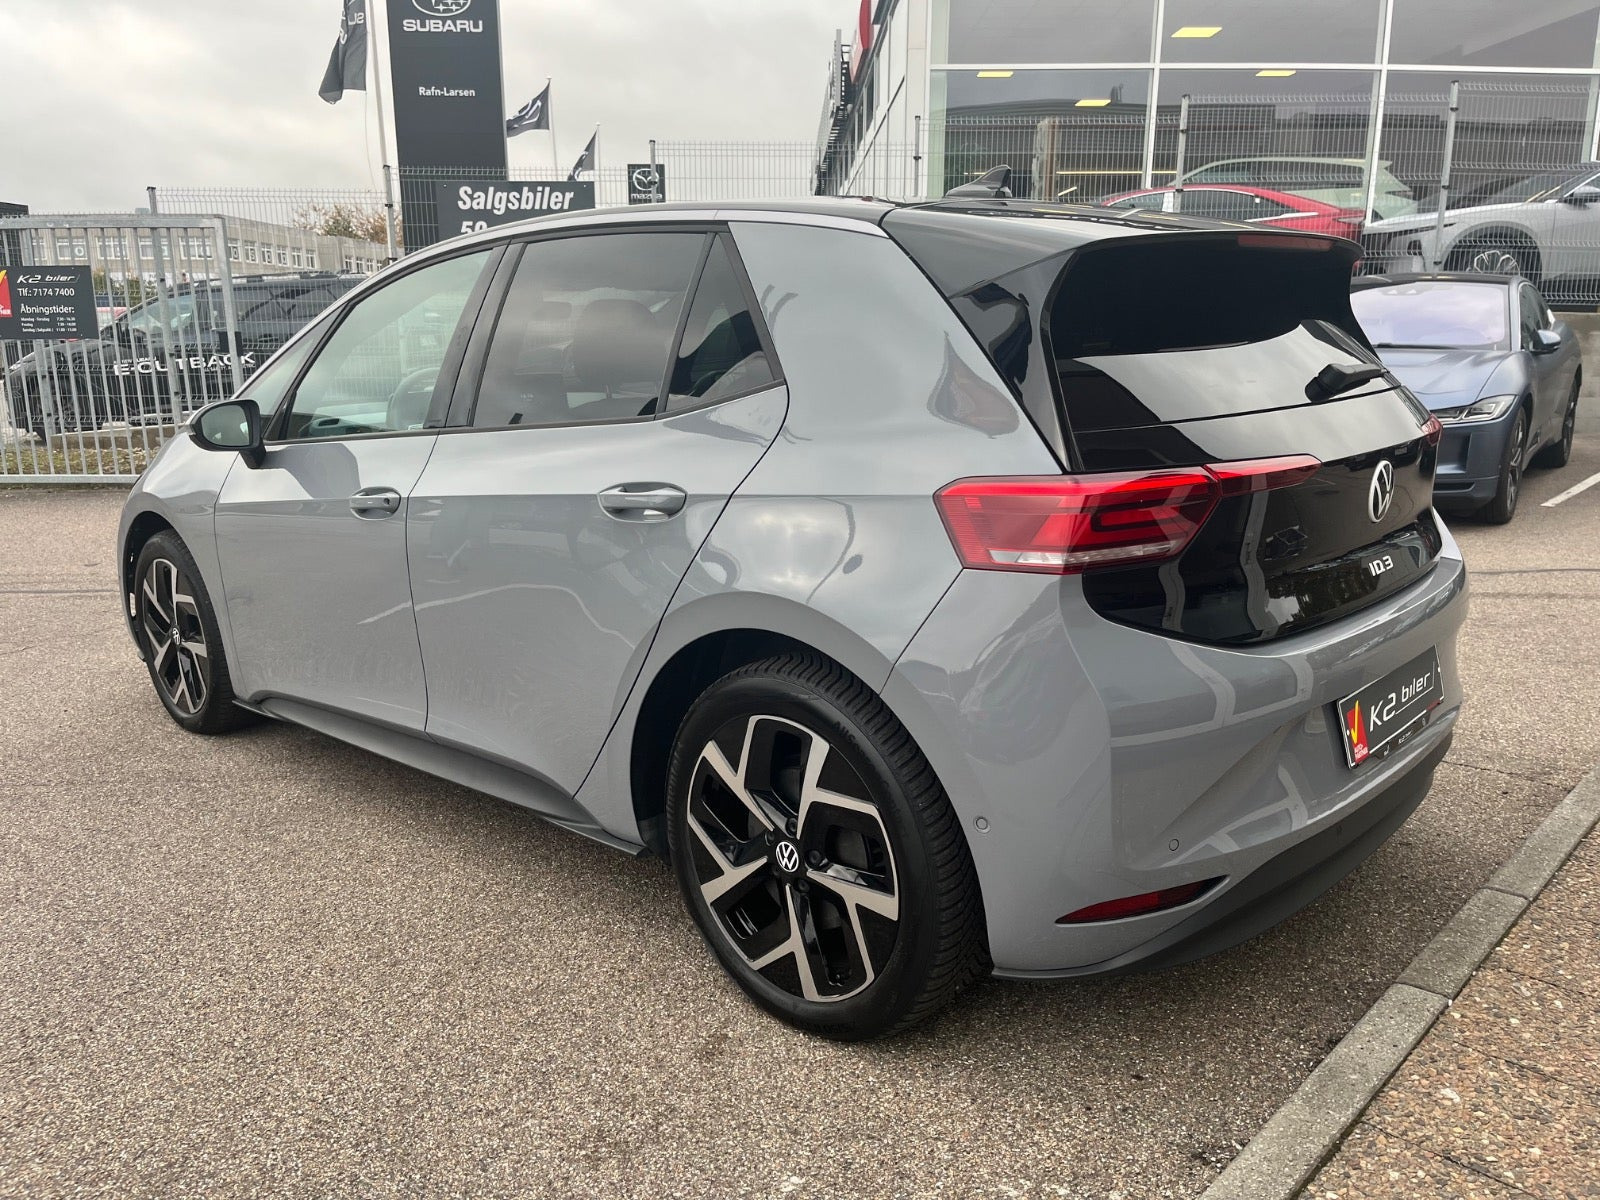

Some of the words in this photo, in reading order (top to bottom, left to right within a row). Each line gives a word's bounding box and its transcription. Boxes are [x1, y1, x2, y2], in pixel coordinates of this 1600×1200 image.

[402, 19, 483, 33] SUBARU
[418, 86, 476, 97] Rafn-Larsen
[457, 186, 575, 216] Salgsbiler
[16, 274, 42, 284] K2
[33, 288, 53, 297] 7174
[54, 288, 75, 297] 7400
[20, 303, 75, 316] Åbningstider:
[1369, 692, 1397, 733] K2
[1401, 672, 1431, 703] biler
